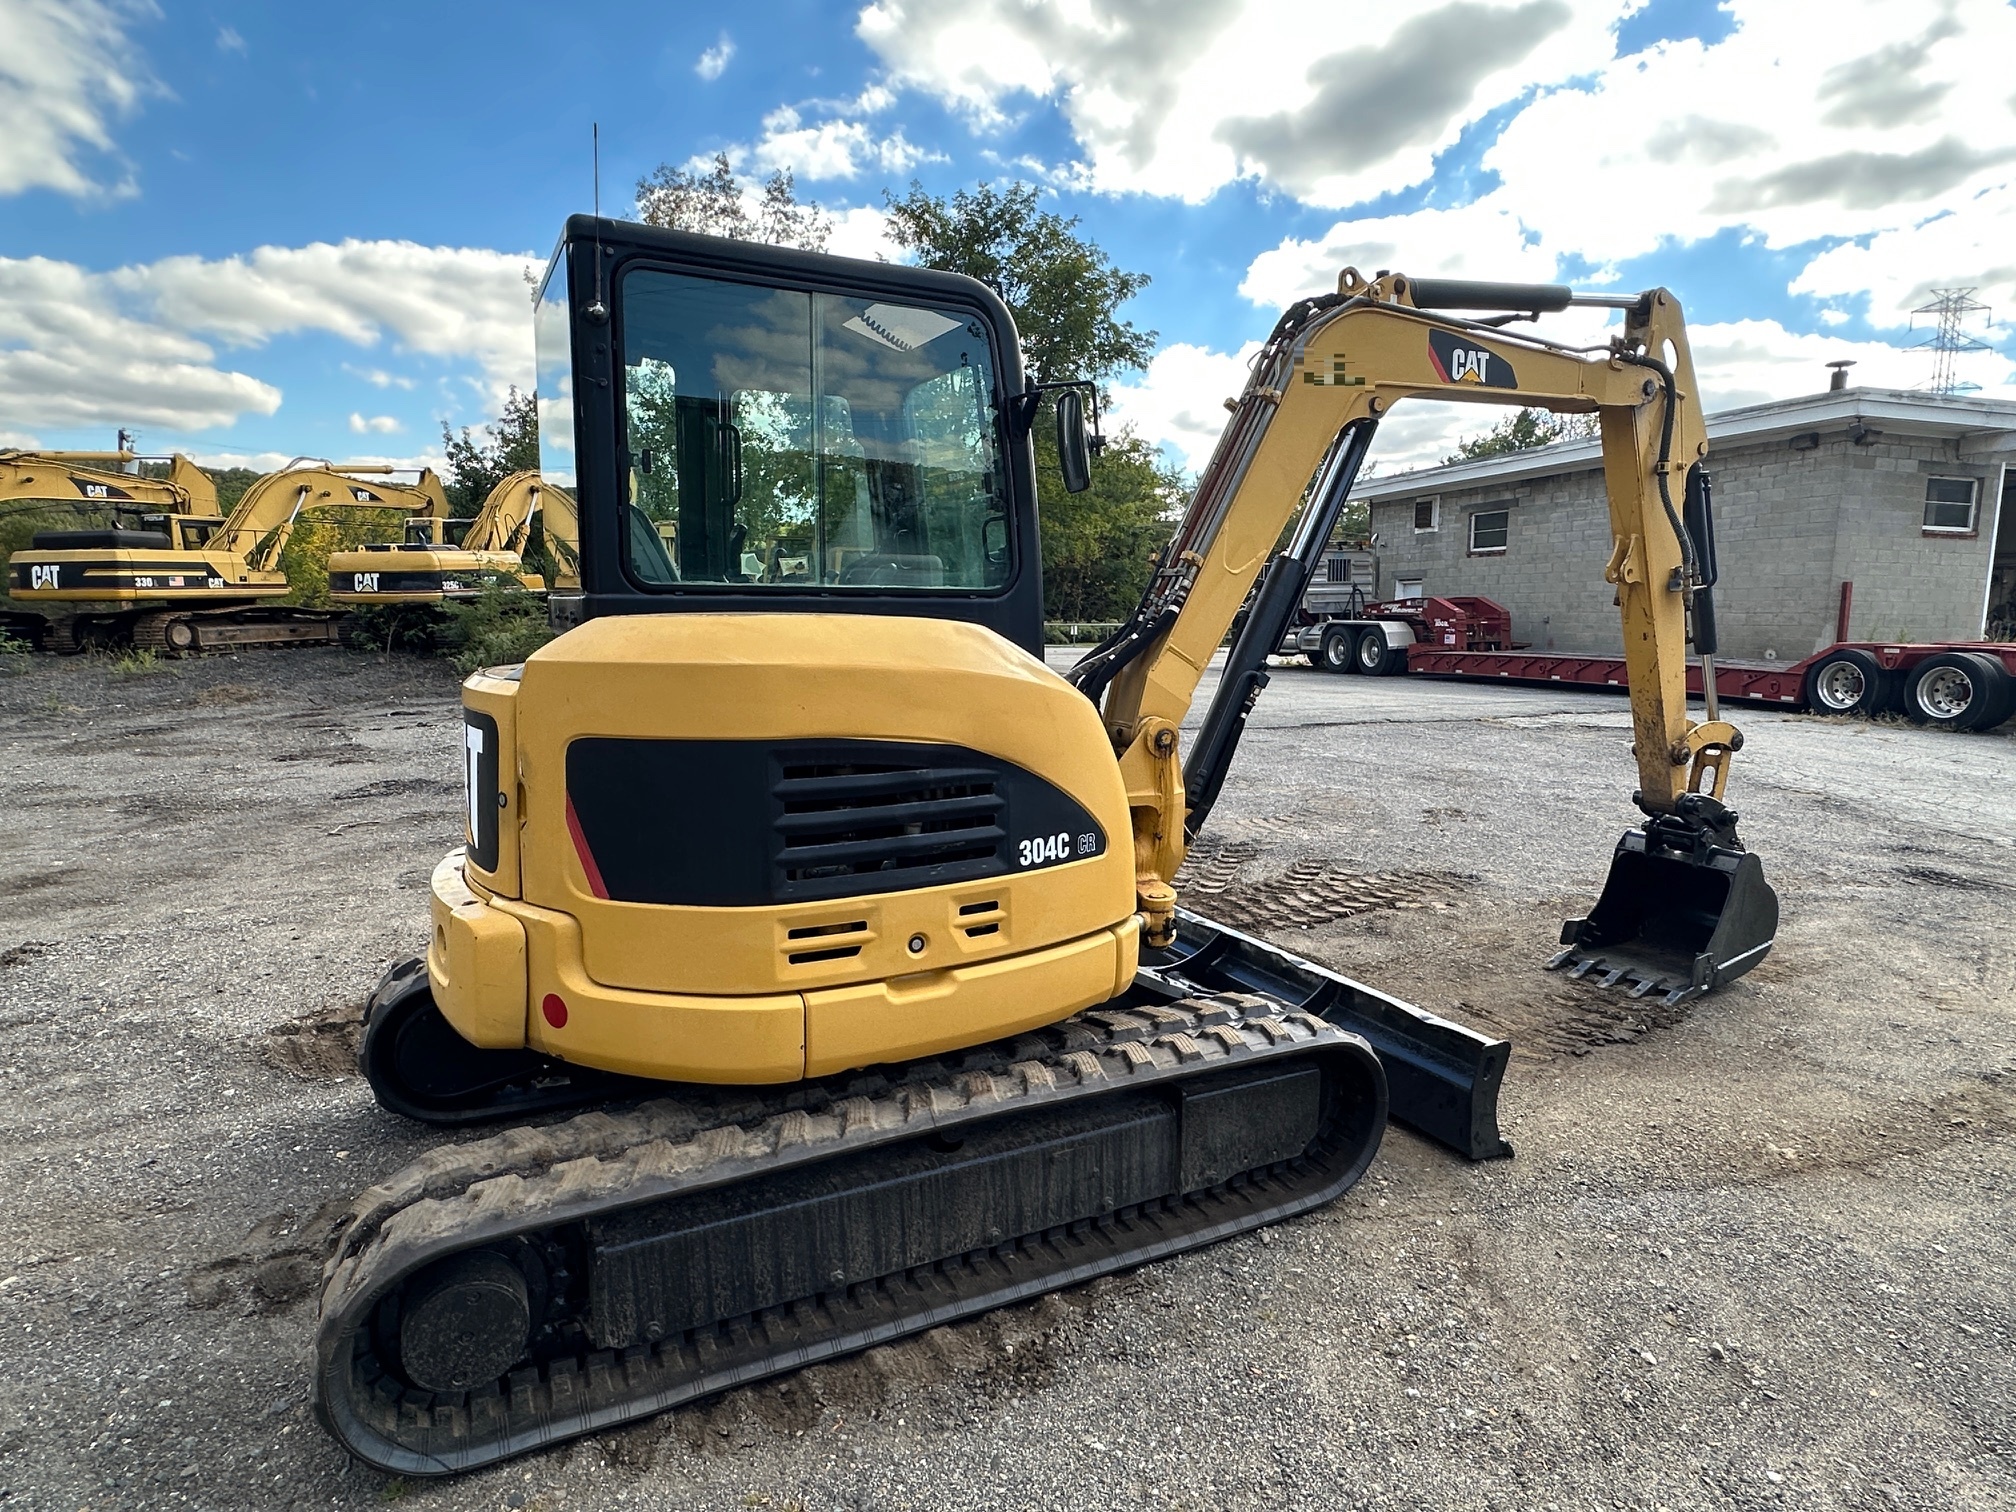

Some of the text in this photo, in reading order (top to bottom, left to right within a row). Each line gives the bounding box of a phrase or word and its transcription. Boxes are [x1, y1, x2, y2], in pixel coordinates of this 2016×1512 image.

[1452, 348, 1490, 383] CAT
[86, 485, 108, 498] CAT
[356, 491, 370, 502] CAT
[31, 565, 60, 590] CAT
[134, 577, 153, 587] 330
[208, 578, 224, 588] CAT
[354, 573, 380, 592] CAT
[1018, 832, 1096, 867] 304C CR
